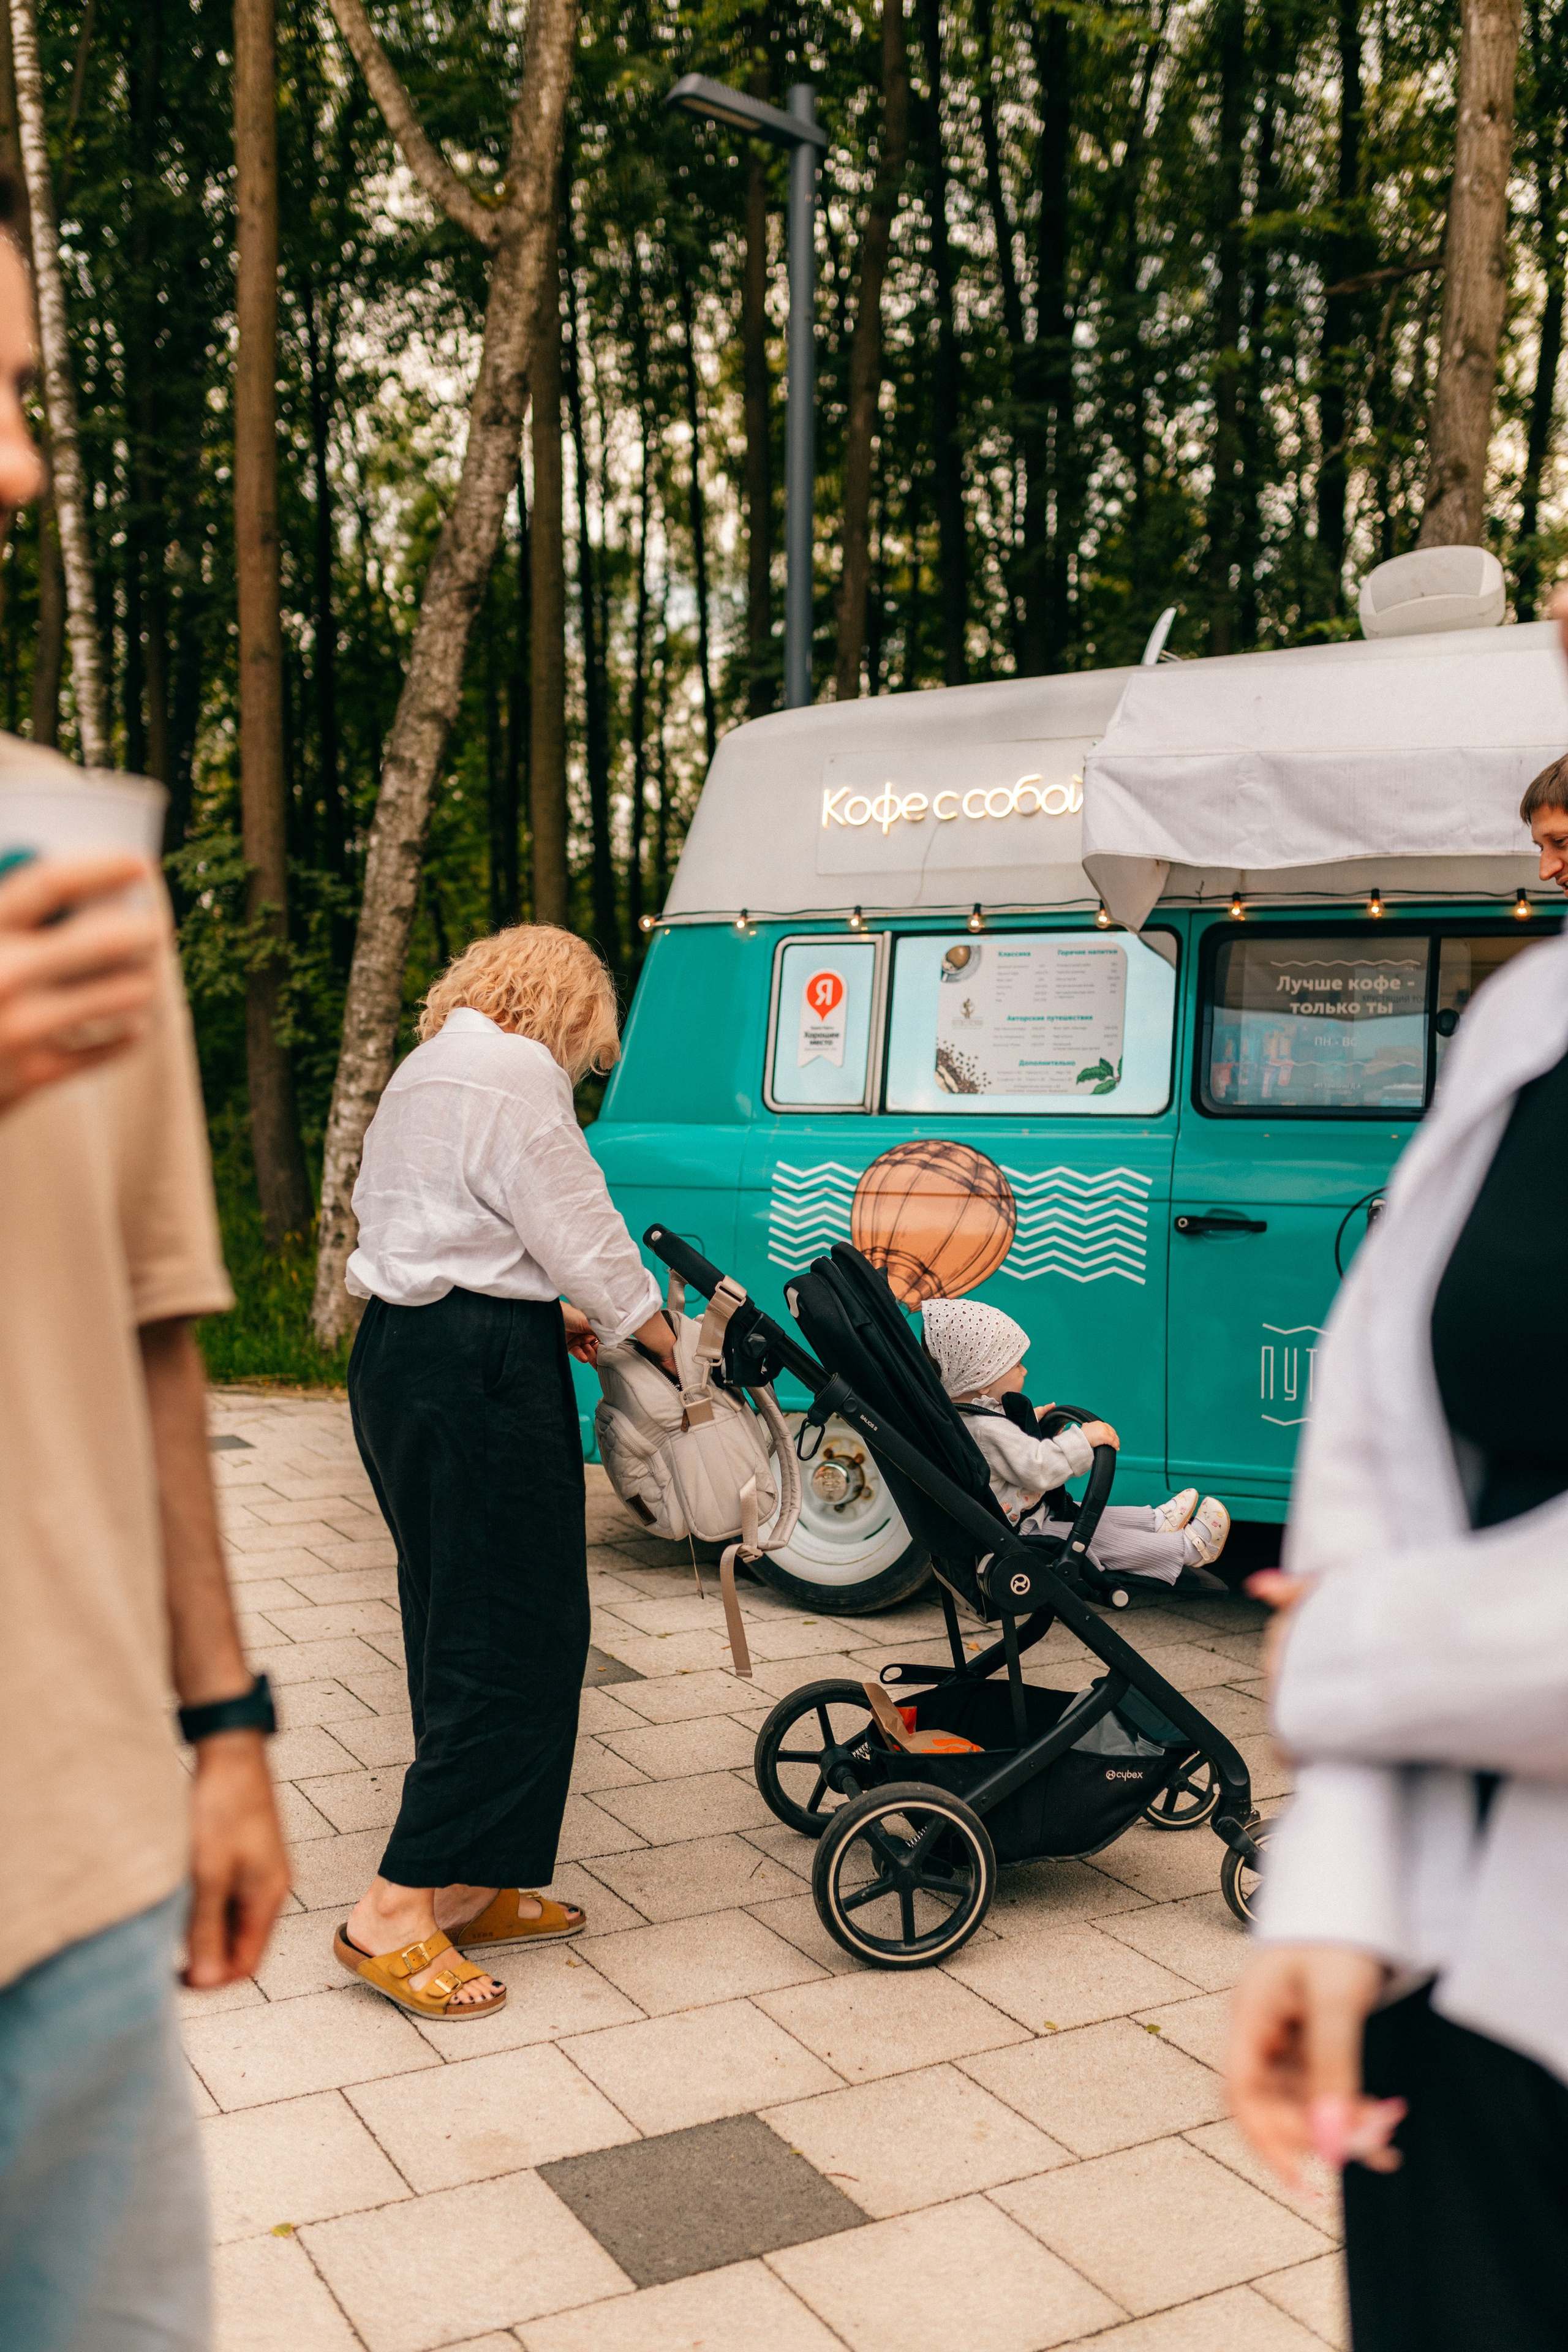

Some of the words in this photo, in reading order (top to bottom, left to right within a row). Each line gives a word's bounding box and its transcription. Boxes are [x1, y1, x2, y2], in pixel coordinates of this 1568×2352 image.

[821, 782, 929, 835] Кофе
[1276, 975, 1343, 995] Лучше
[1349, 974, 1401, 994] кофе
[1289, 1001, 1361, 1014] только
[1366, 1001, 1393, 1014] ты
[1314, 1036, 1331, 1046] ПН
[860, 1414, 875, 1428] BALIOS
[1116, 1769, 1143, 1782] cybex
